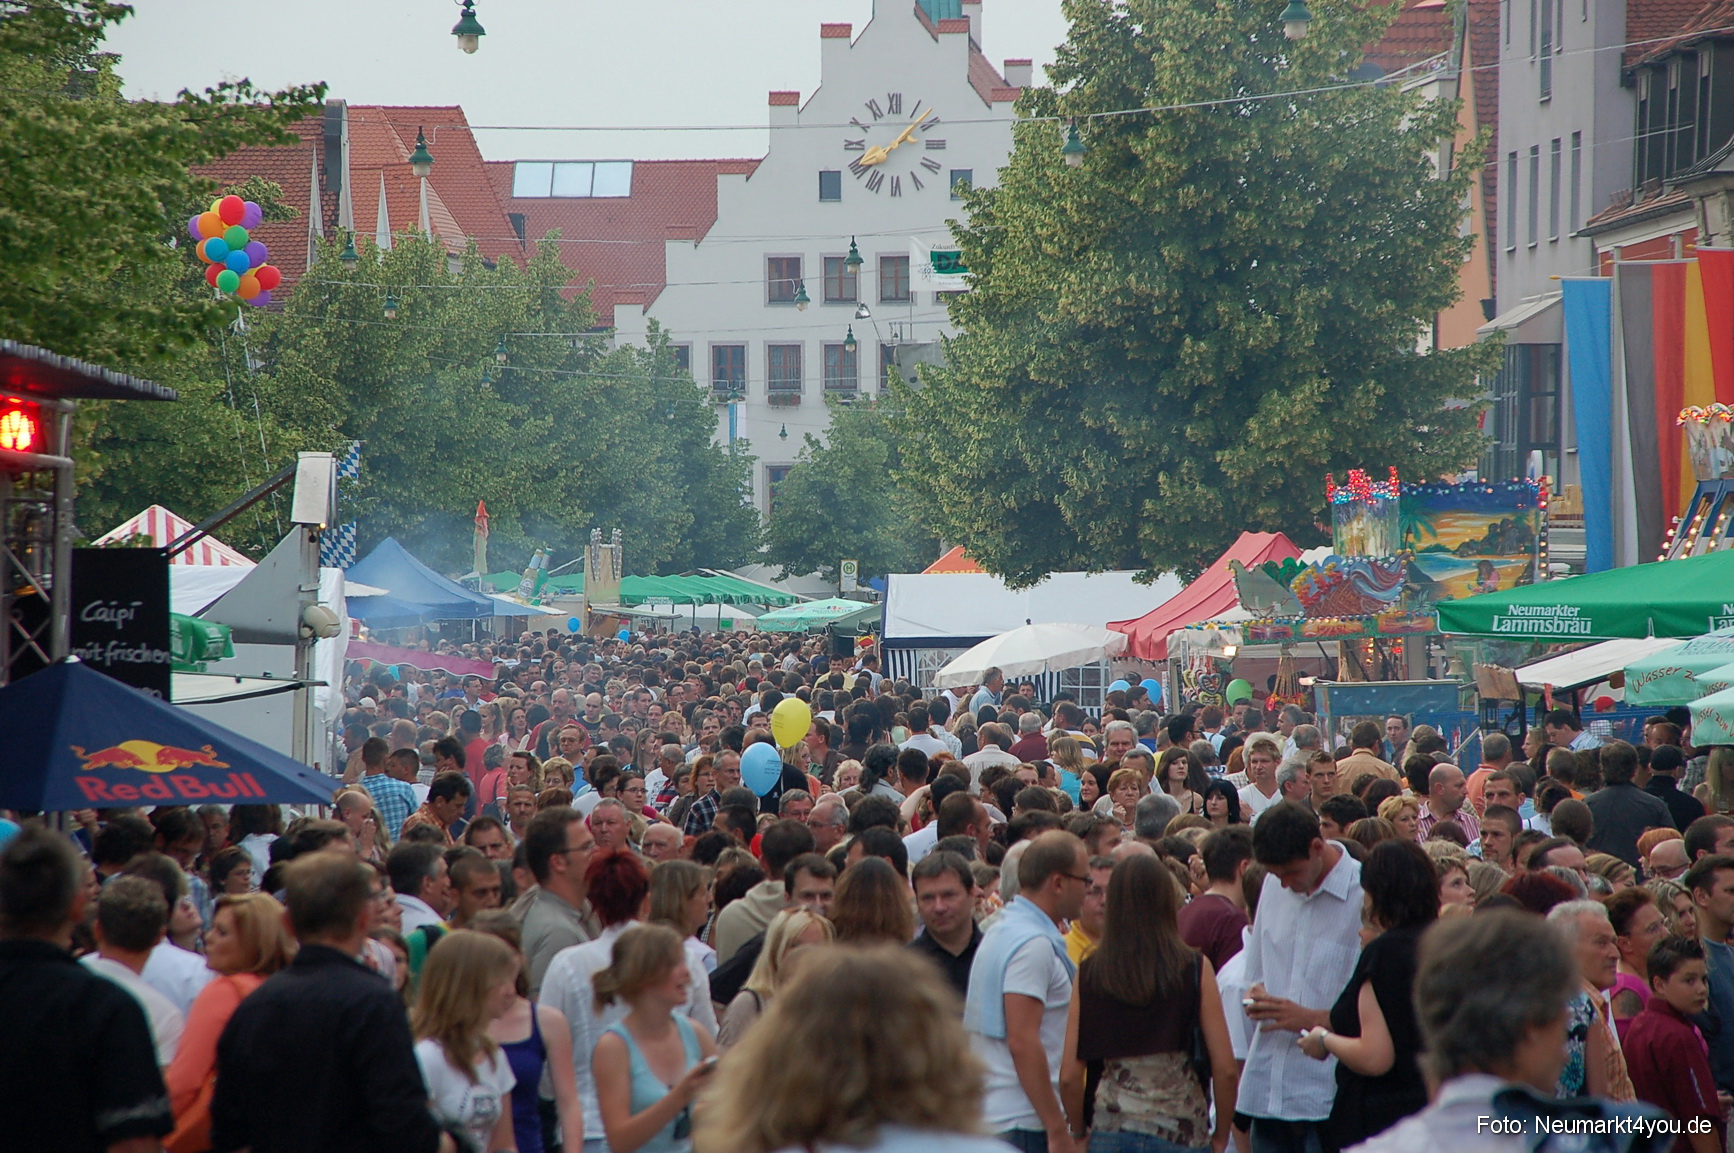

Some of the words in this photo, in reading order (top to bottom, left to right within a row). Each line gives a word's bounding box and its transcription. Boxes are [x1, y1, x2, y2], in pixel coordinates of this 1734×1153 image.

[865, 98, 884, 121] XI
[887, 93, 902, 114] XII
[844, 139, 865, 151] IX
[925, 139, 946, 150] III
[865, 168, 885, 194] VII
[890, 175, 902, 197] VI
[80, 600, 143, 629] Caipi
[1508, 604, 1581, 617] Neumarkter
[1492, 615, 1592, 634] Lammsbräu
[103, 639, 170, 667] frischen
[1632, 666, 1682, 694] Wasser
[75, 774, 175, 801] Red
[169, 773, 267, 798] Bull
